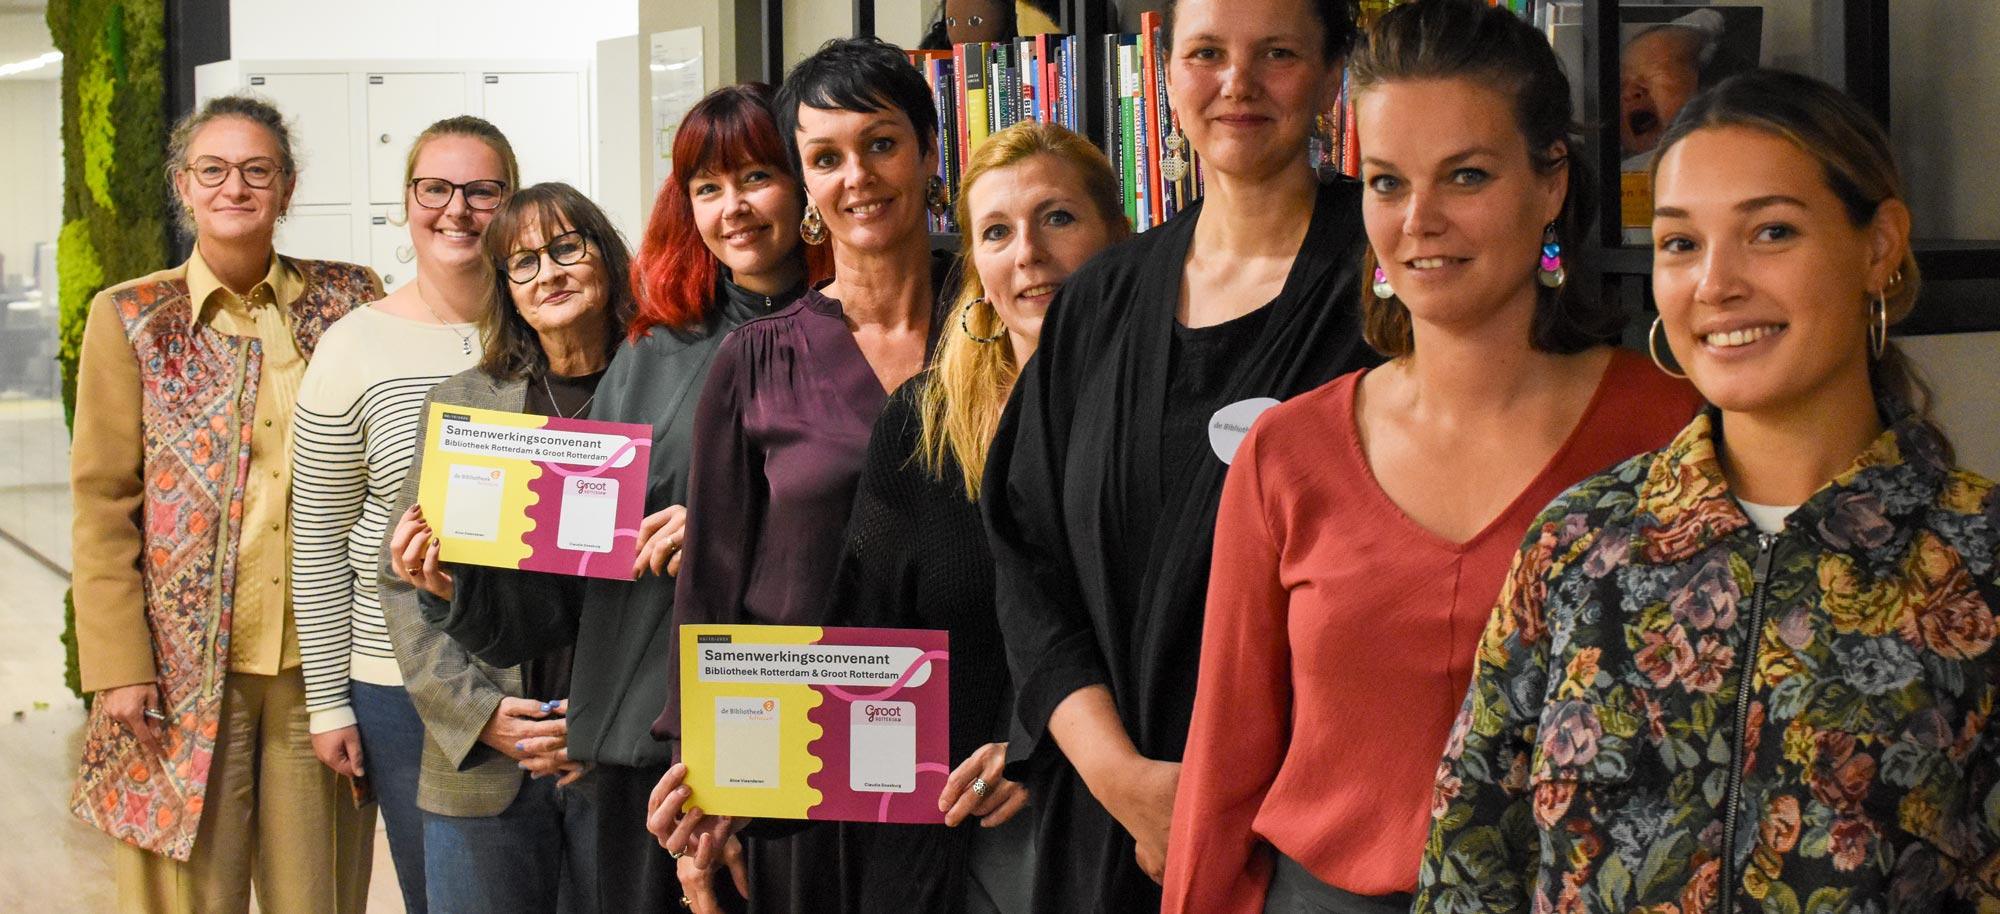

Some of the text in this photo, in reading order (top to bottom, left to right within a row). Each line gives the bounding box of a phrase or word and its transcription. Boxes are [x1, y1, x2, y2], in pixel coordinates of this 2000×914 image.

[998, 50, 1006, 92] MINTZBERG
[1214, 422, 1222, 430] de
[446, 425, 602, 449] Samenwerkingsconvenant
[445, 439, 490, 450] Bibliotheek
[492, 444, 534, 455] Rotterdam
[542, 449, 565, 458] Groot
[566, 451, 608, 461] Rotterdam
[576, 479, 607, 494] Groot
[705, 649, 890, 665] Samenwerkingsconvenant
[705, 666, 899, 680] Bibliotheek Rotterdam & Groot Rotterdam
[865, 704, 901, 722] Groot
